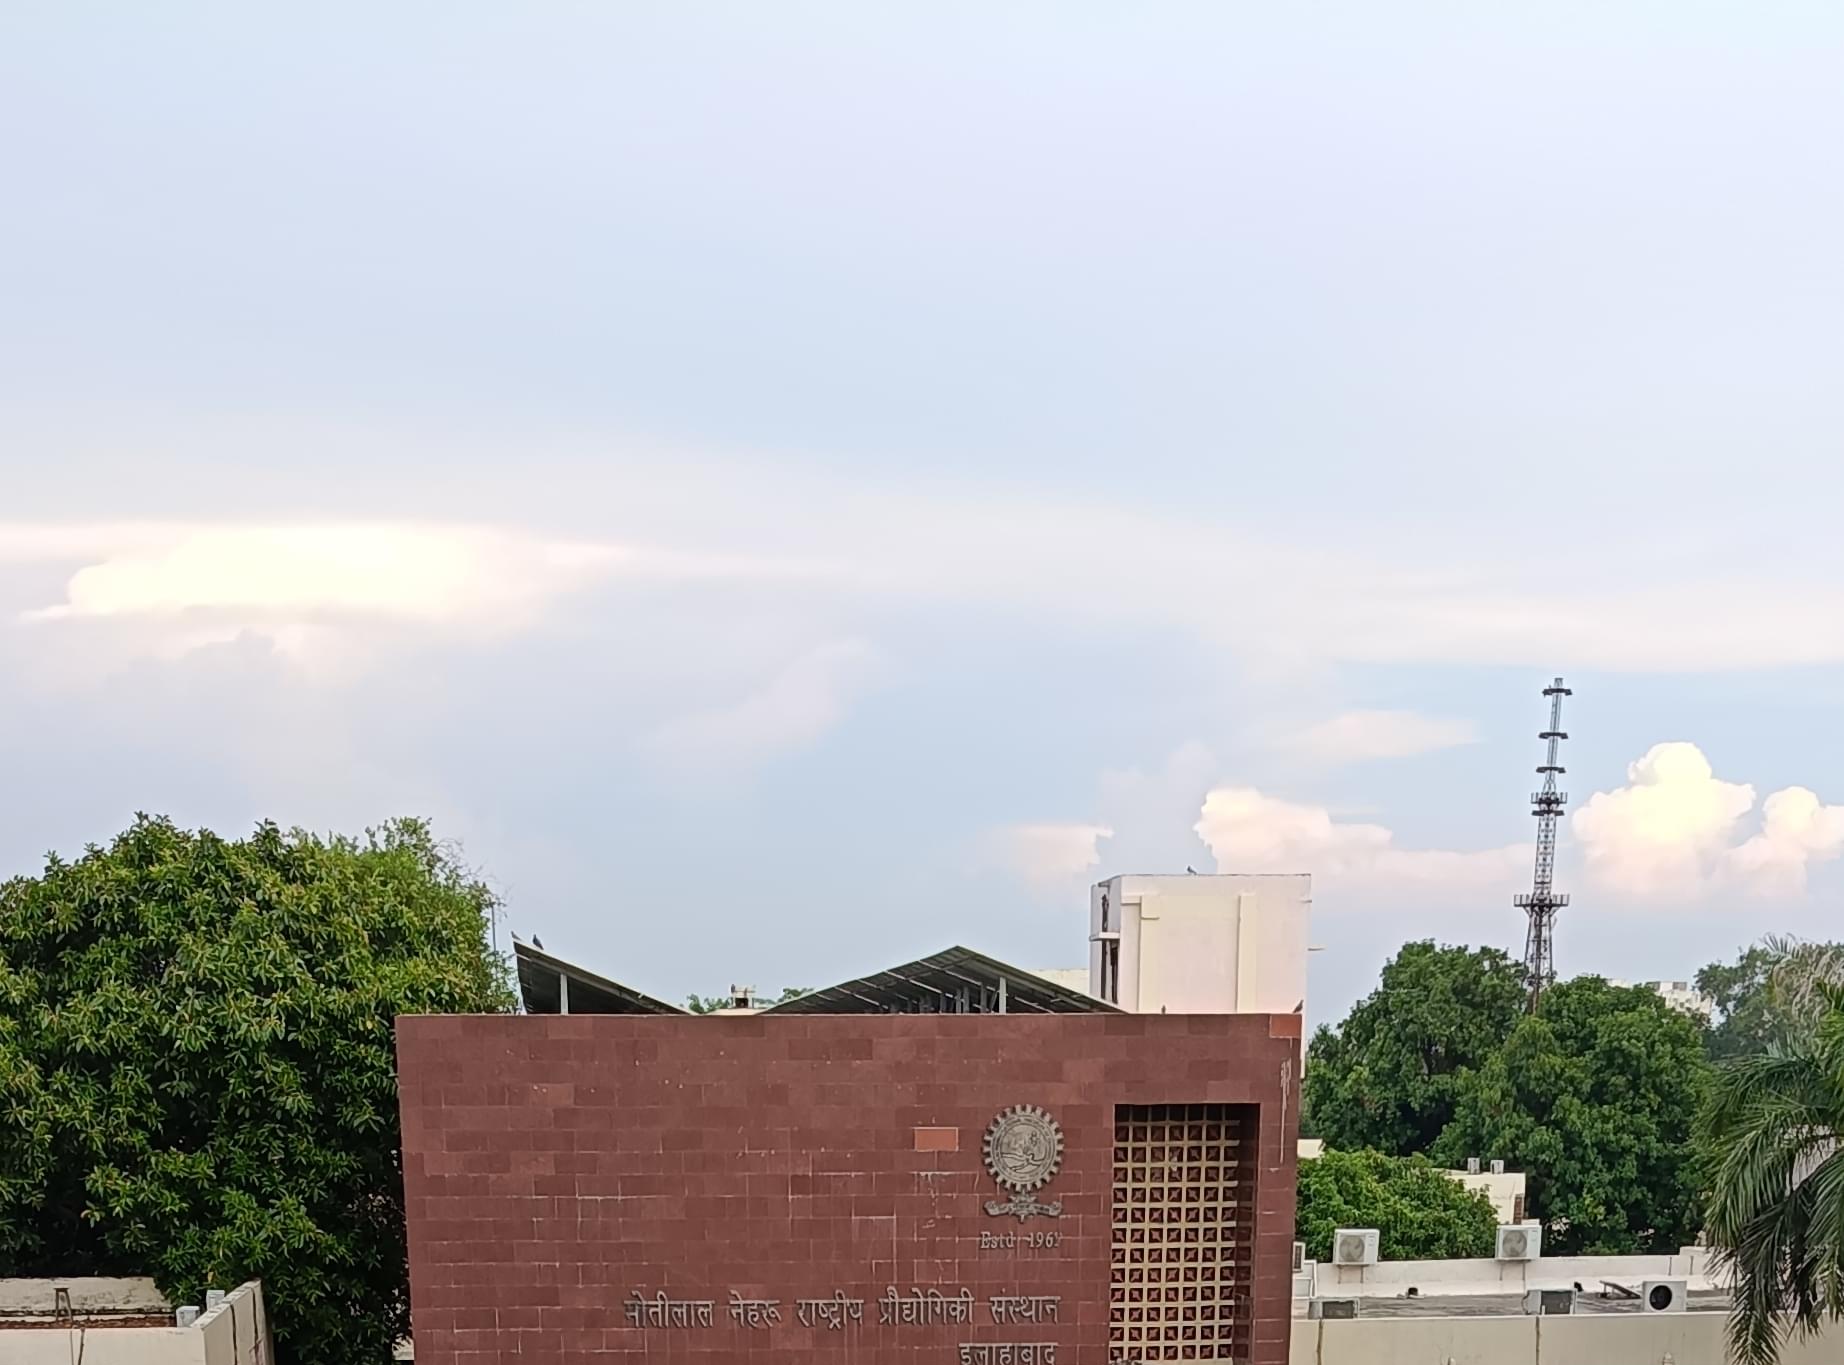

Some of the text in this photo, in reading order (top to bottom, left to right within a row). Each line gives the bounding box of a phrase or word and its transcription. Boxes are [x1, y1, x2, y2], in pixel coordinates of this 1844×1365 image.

[624, 1286, 1061, 1330] मोतीलाल नेहरू राष्ट्रीय प्रौद्योगिकी संस्थान
